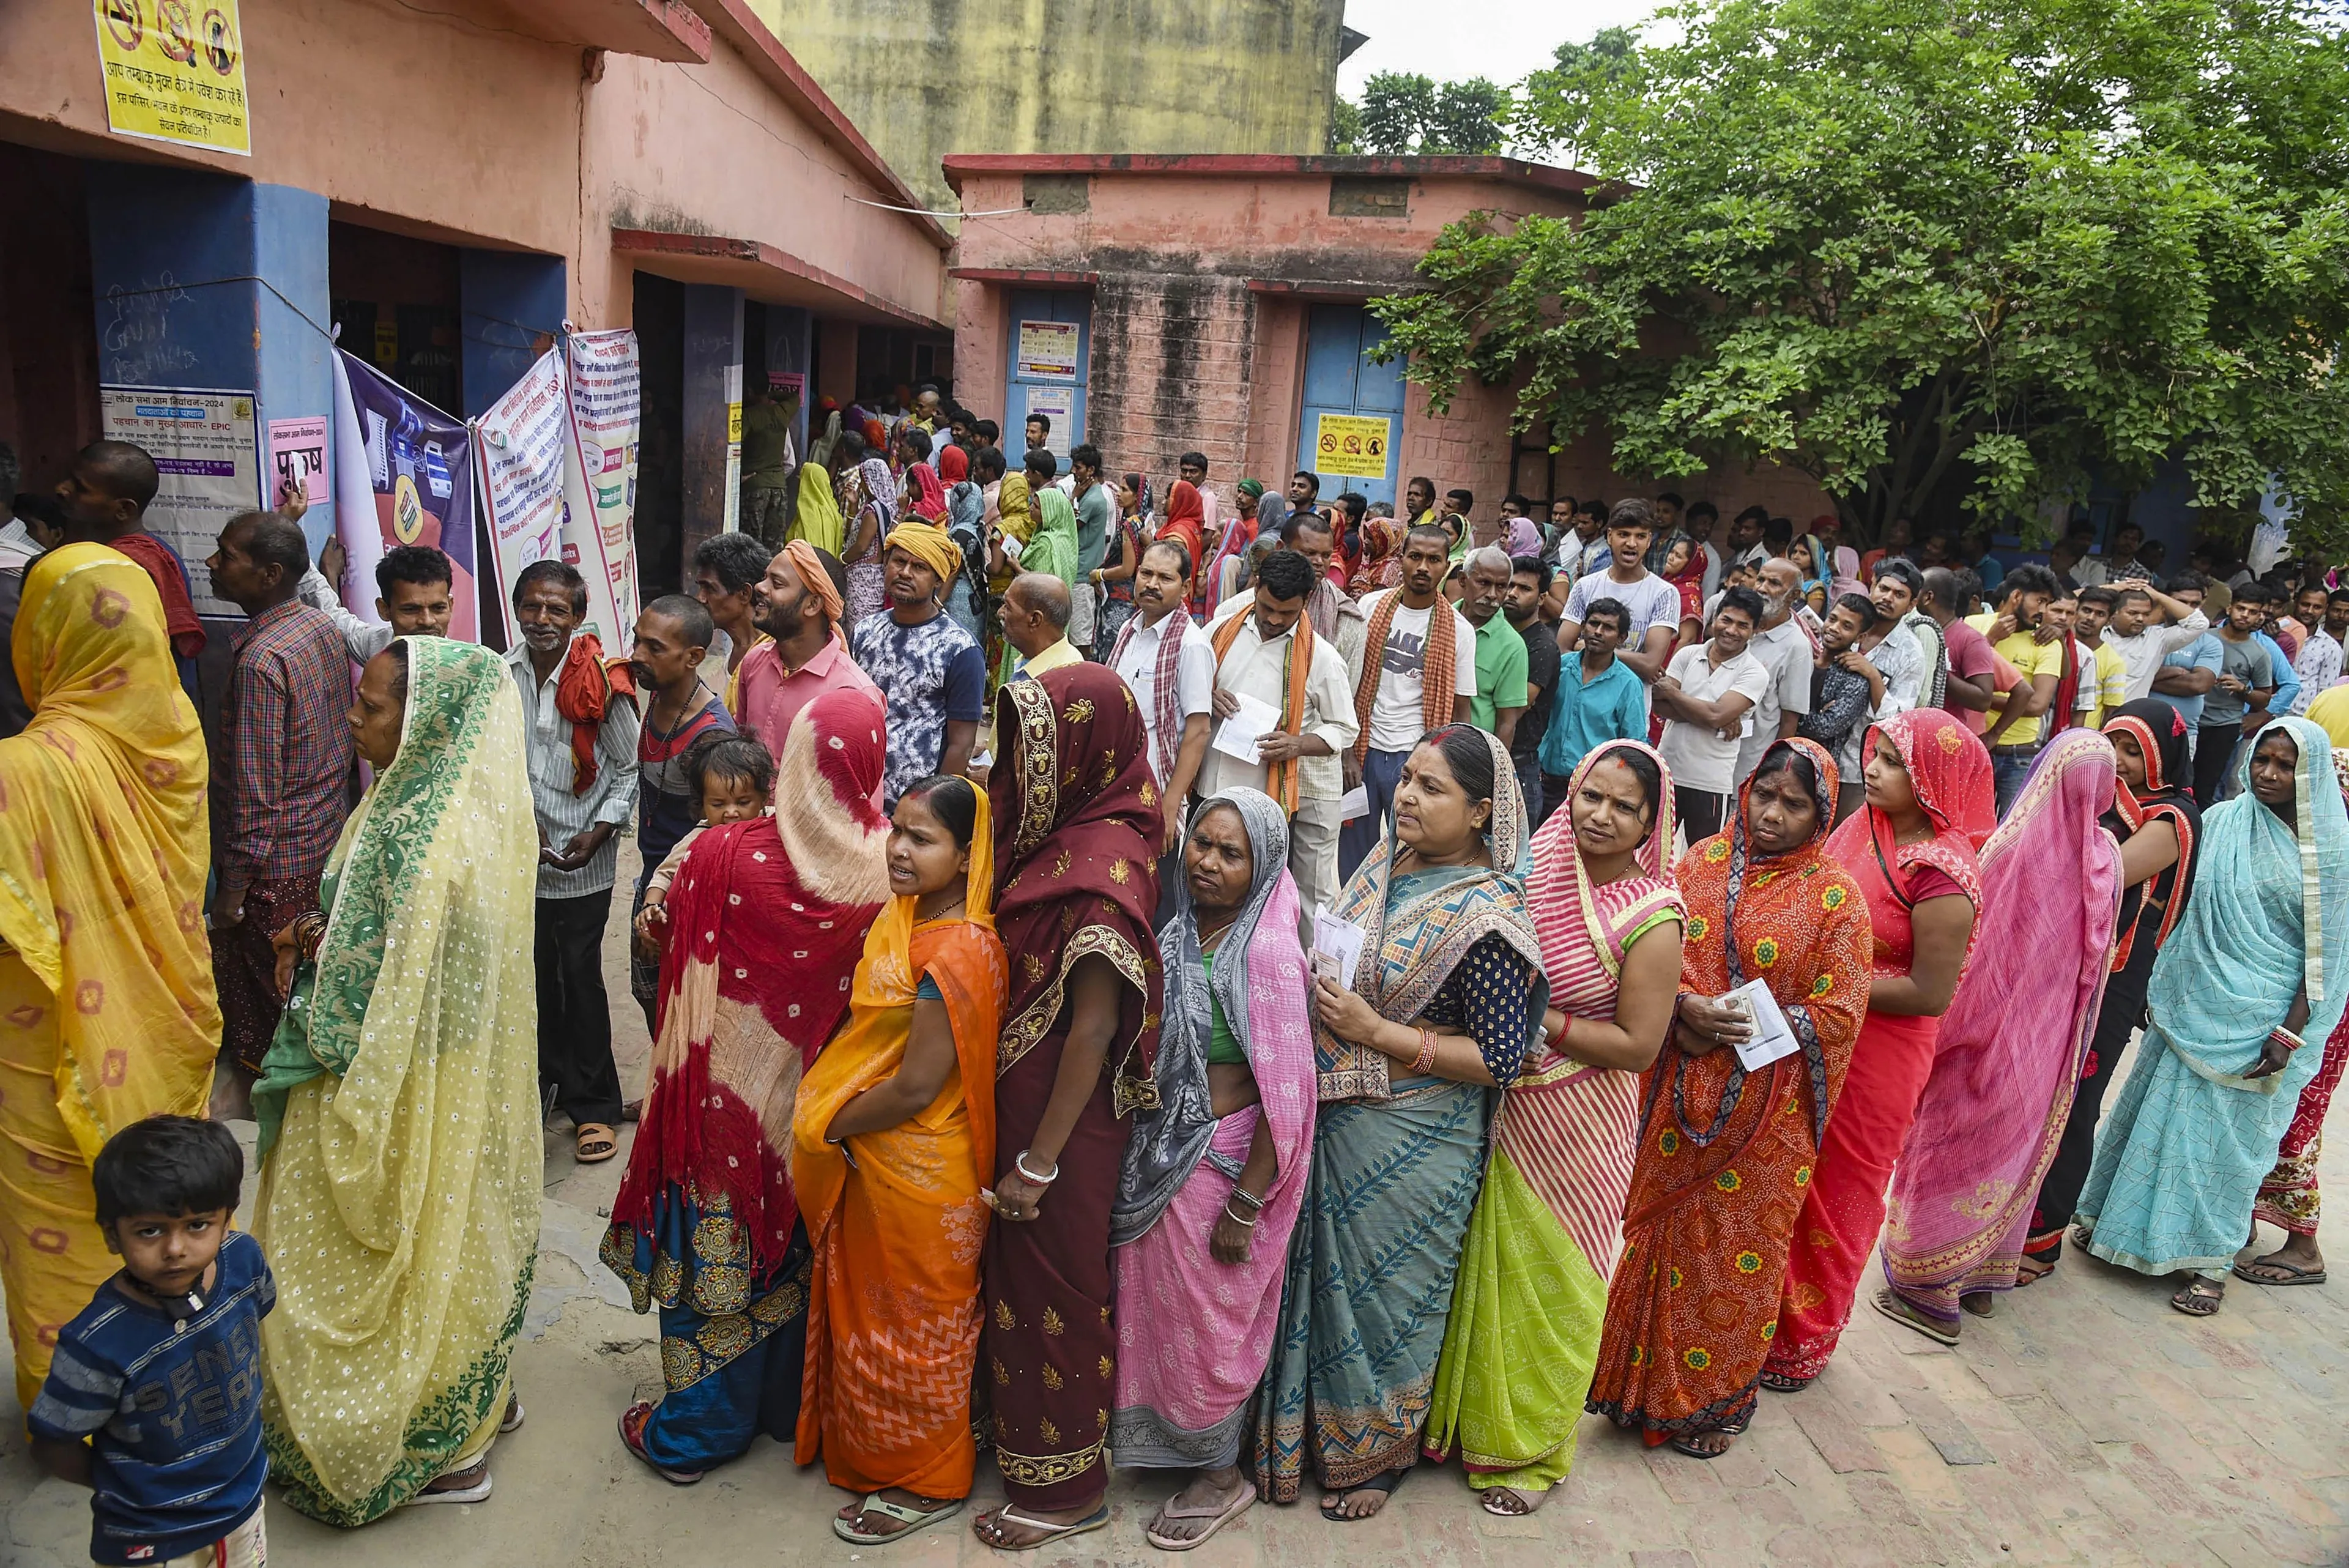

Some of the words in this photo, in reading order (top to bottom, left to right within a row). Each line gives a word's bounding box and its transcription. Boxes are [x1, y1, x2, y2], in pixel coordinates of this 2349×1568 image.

[106, 61, 123, 78] आप
[125, 65, 154, 92] तम्बाकू
[215, 87, 227, 103] कर
[228, 87, 236, 106] रहे
[116, 92, 127, 104] इस
[169, 100, 177, 114] के
[232, 117, 242, 127] का
[114, 393, 134, 404] लोक
[135, 396, 150, 404] सभा
[113, 418, 139, 427] पहचान
[143, 419, 154, 428] का
[157, 420, 176, 431] मुख्य
[211, 422, 231, 431] EPIC
